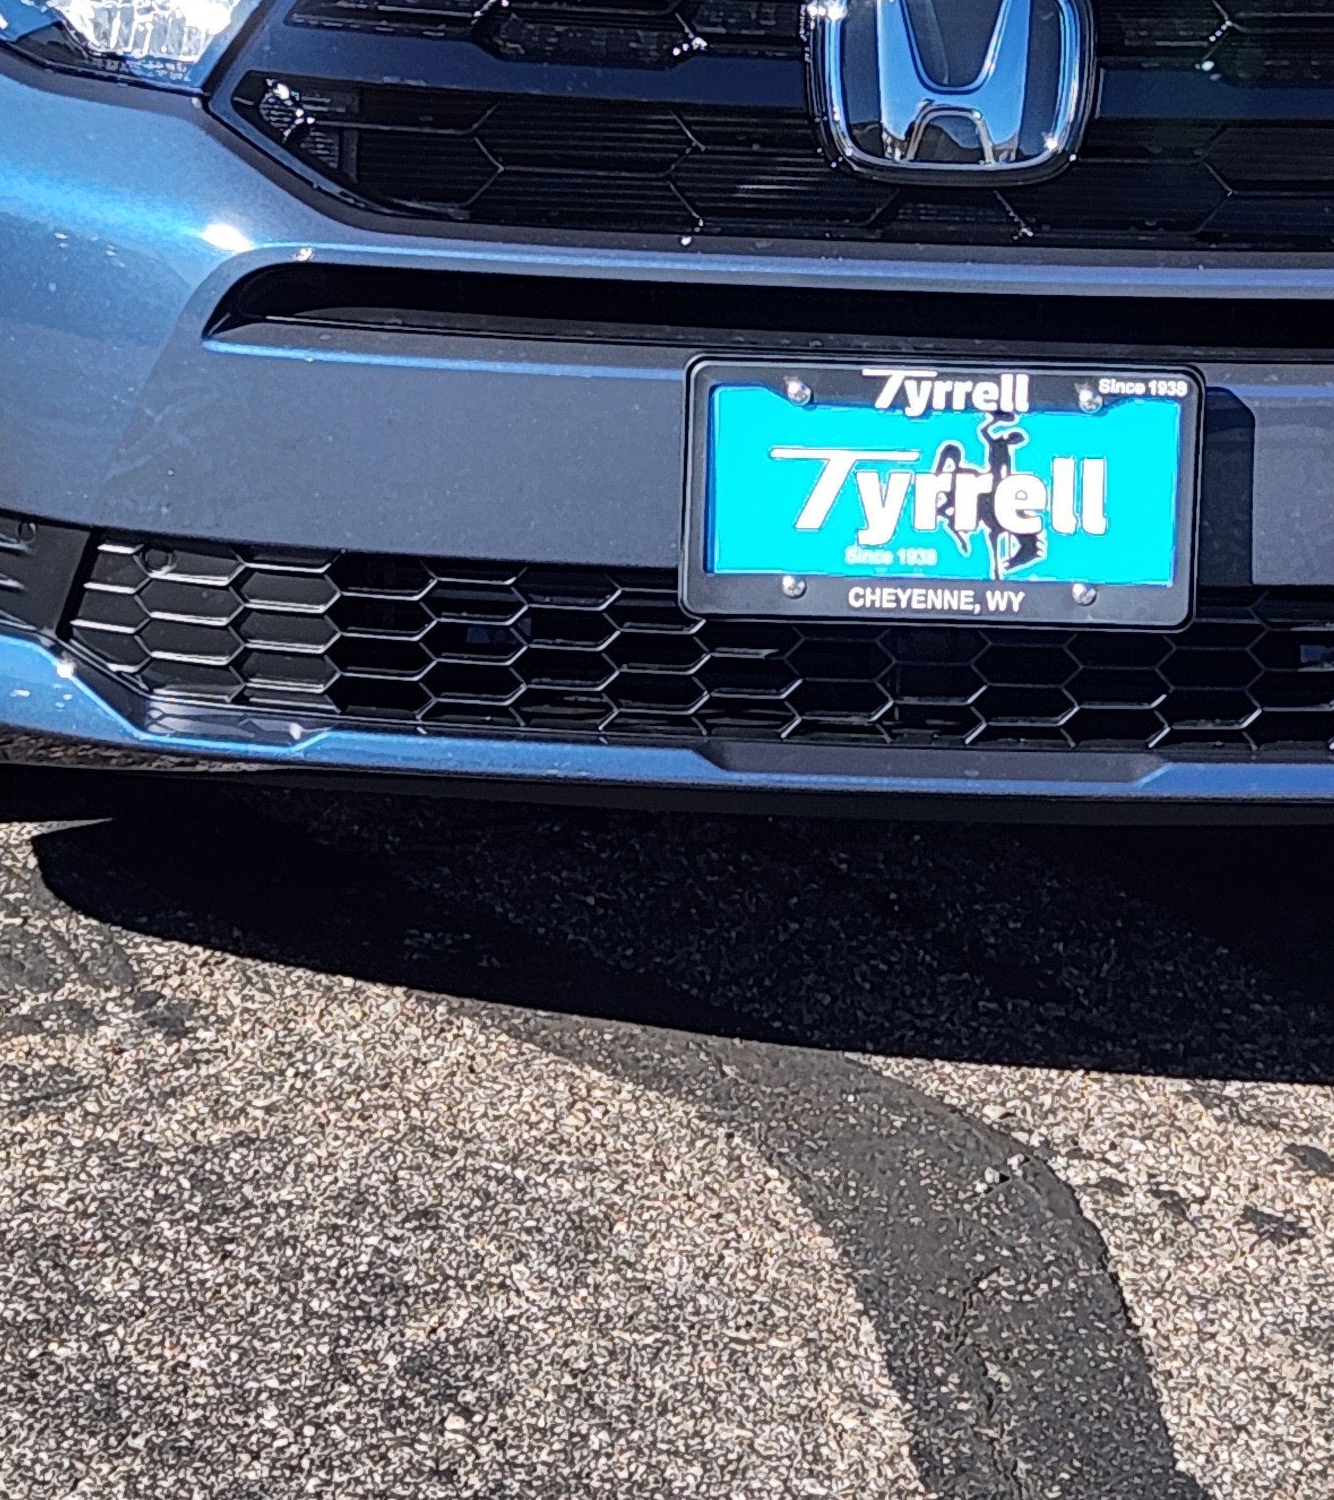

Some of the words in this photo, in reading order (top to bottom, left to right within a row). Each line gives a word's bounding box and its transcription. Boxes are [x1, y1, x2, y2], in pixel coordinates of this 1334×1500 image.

[862, 368, 1029, 417] Tyrrell
[1099, 378, 1146, 395] Since
[1148, 380, 1188, 397] 1938
[770, 448, 1107, 546] Tyrrell
[848, 586, 981, 614] CHEYENNE,
[985, 590, 1026, 613] WY
